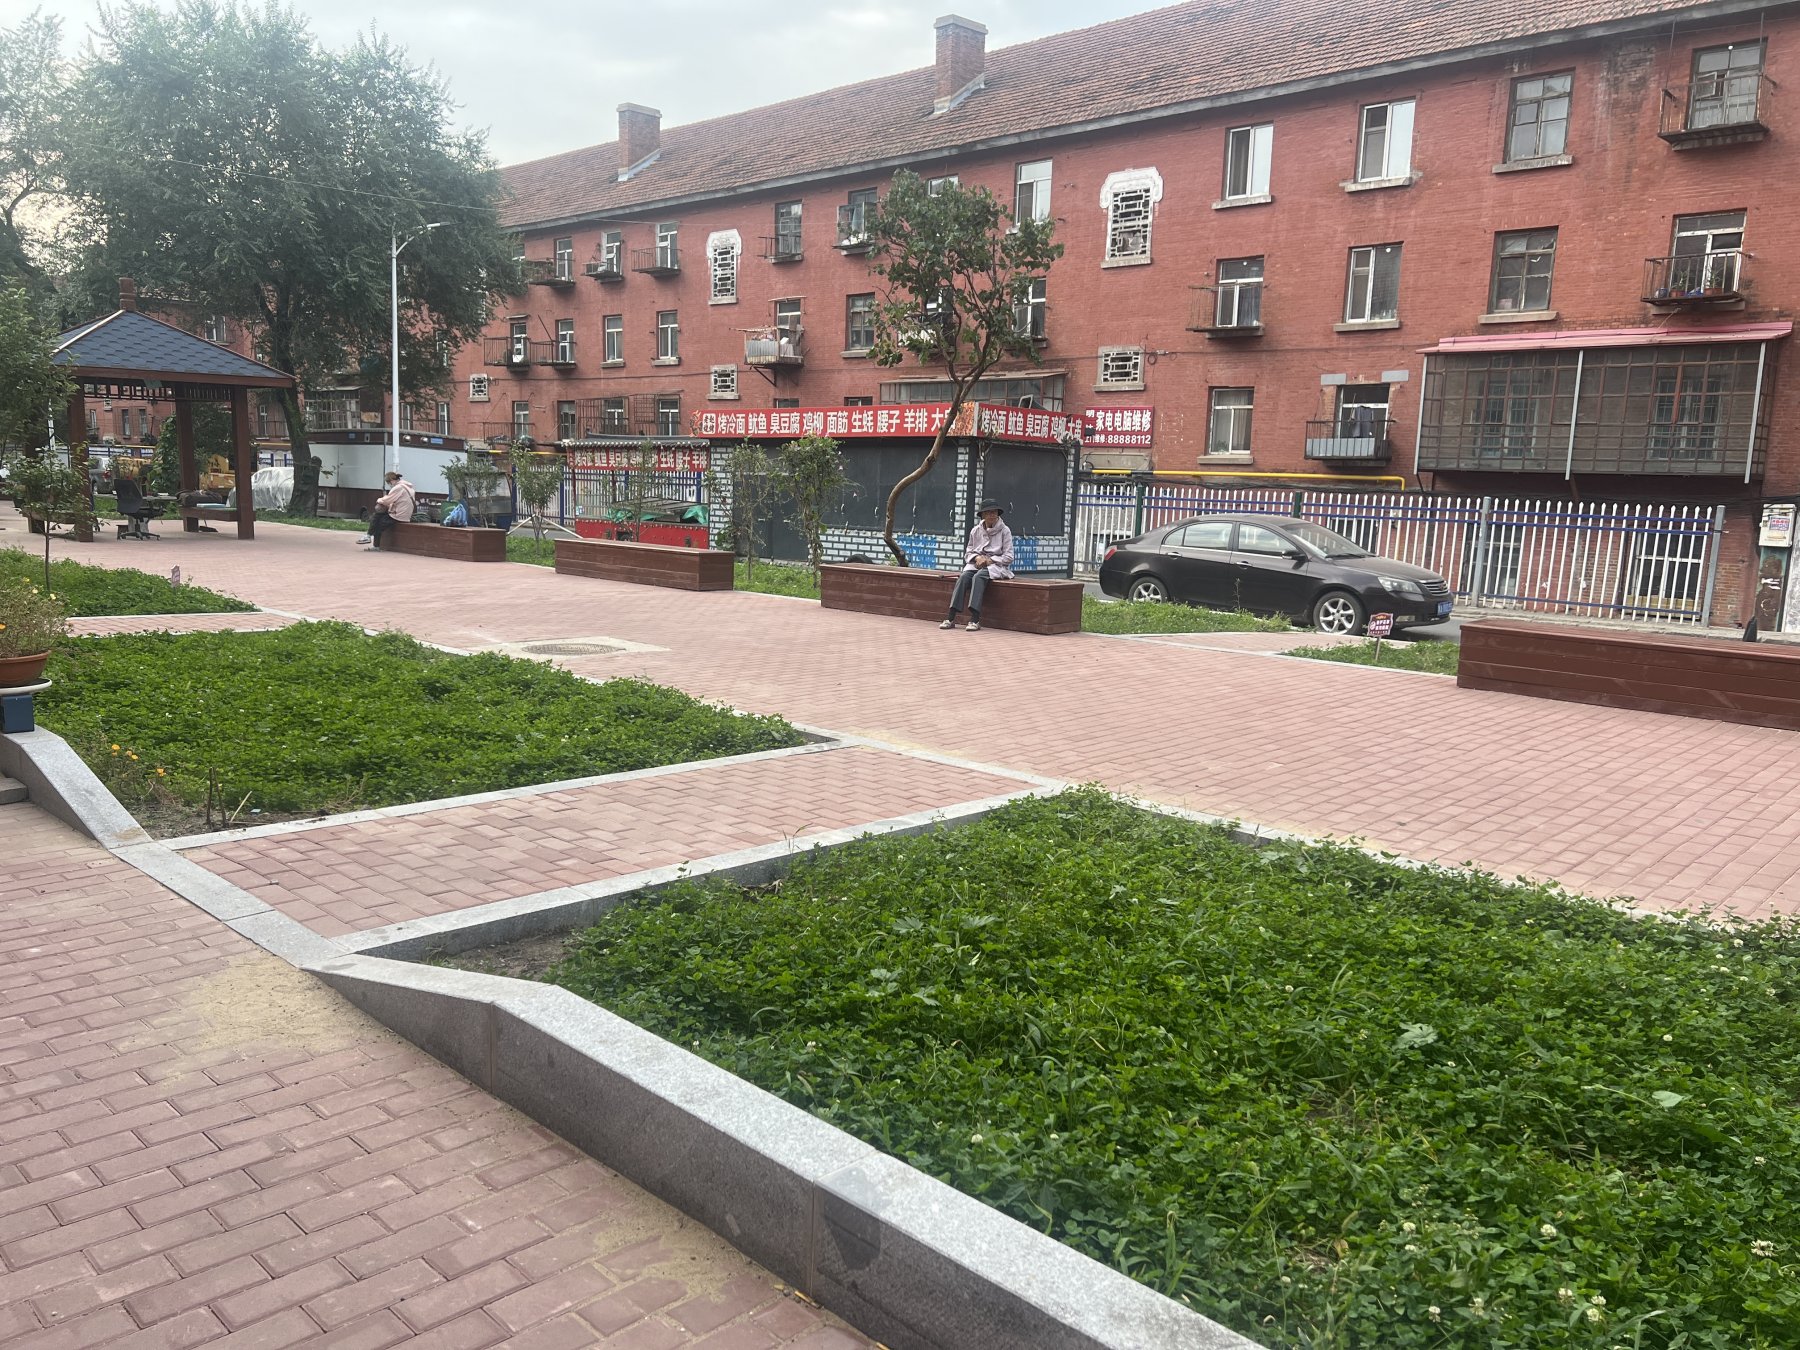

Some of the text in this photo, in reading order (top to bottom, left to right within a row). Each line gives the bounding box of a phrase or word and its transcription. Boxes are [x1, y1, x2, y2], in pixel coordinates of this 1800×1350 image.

[718, 412, 746, 435] 烤冷面
[748, 412, 768, 434] 鱿鱼
[770, 411, 800, 434] 臭豆腐
[802, 411, 824, 435] 鸡柳
[826, 410, 849, 434] 面筋
[851, 410, 873, 433] 生蚝
[876, 409, 901, 433] 腰子
[903, 407, 928, 433] 羊排
[980, 407, 1007, 435] 烤冷面
[1007, 410, 1024, 436] 鱿鱼
[1025, 413, 1050, 438] 臭豆腐
[1095, 409, 1151, 432] 家电电脑维修
